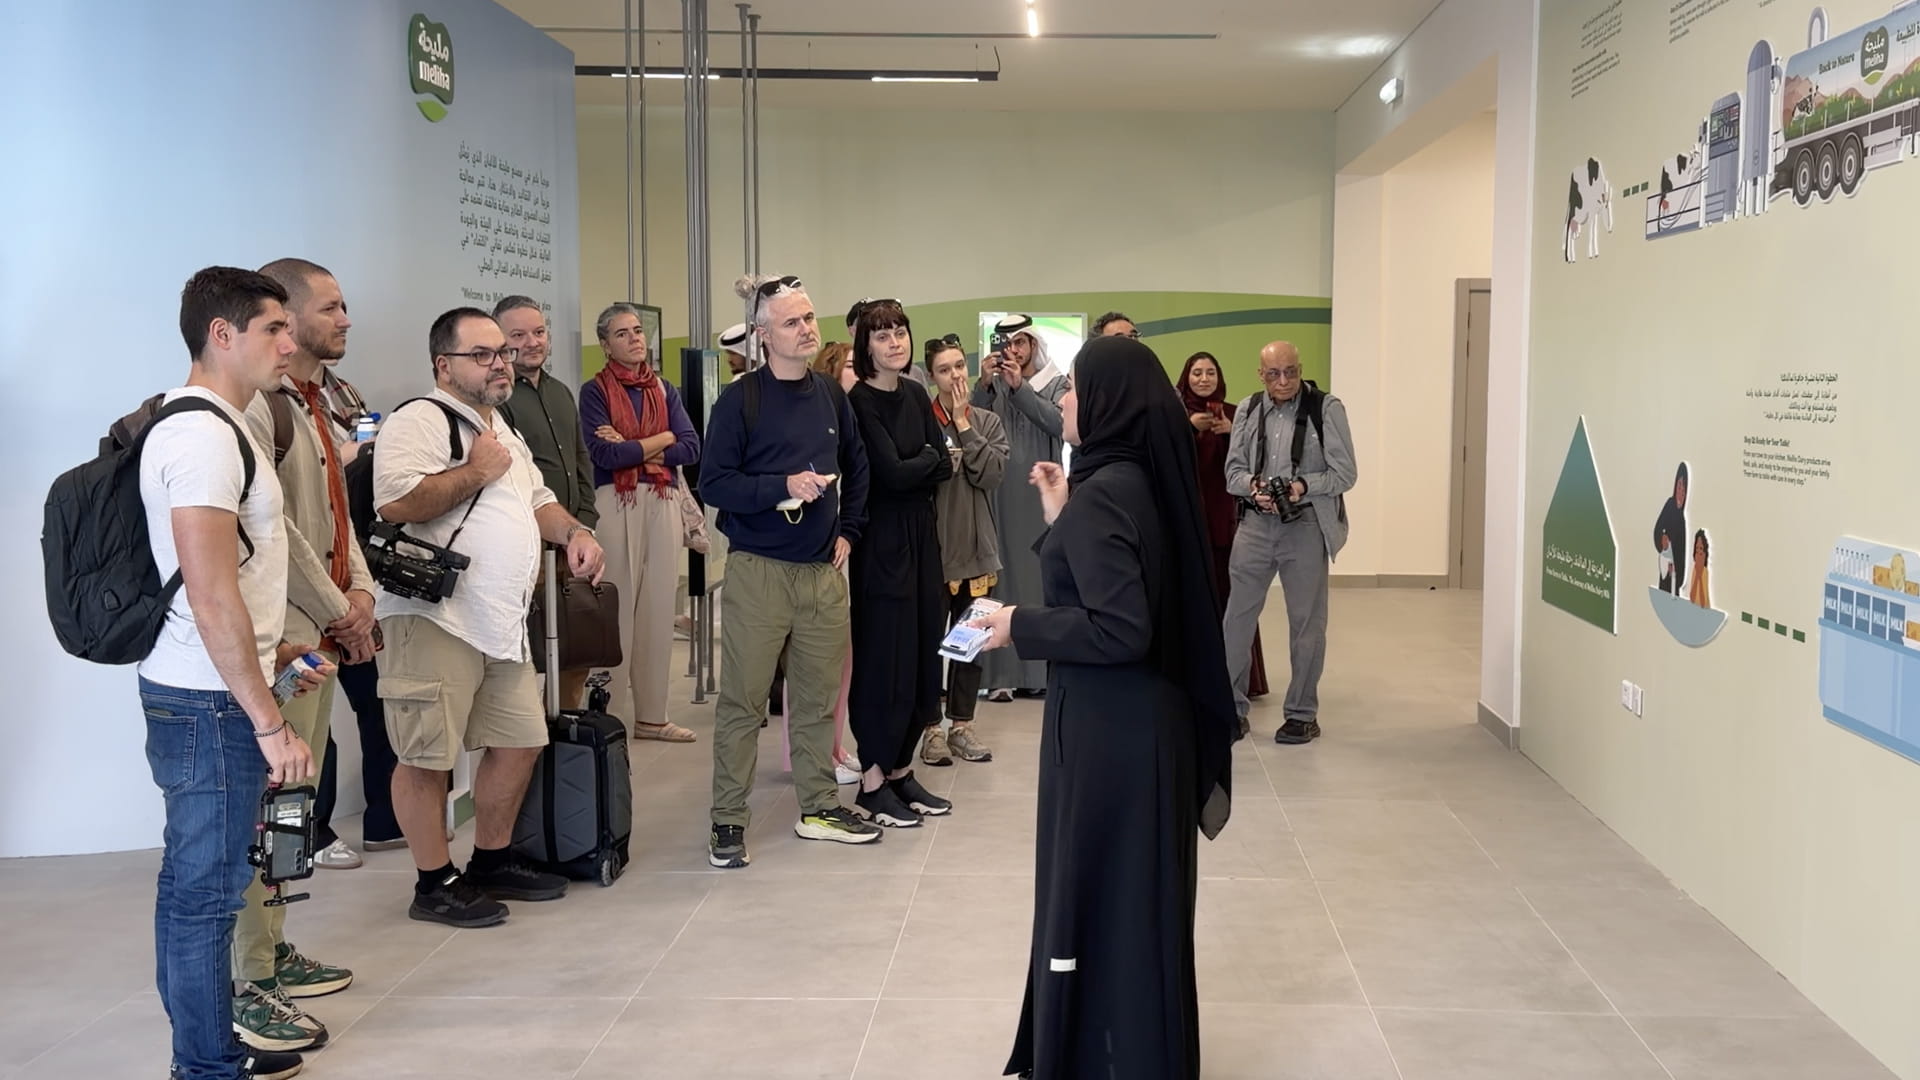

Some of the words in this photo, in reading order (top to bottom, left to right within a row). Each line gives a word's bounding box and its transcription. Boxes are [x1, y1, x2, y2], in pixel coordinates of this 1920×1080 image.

[418, 21, 450, 63] مليحة
[1840, 601, 1853, 615] MILK
[1856, 605, 1869, 620] MILK
[1873, 611, 1887, 625] MILK
[1891, 617, 1904, 632] MILK
